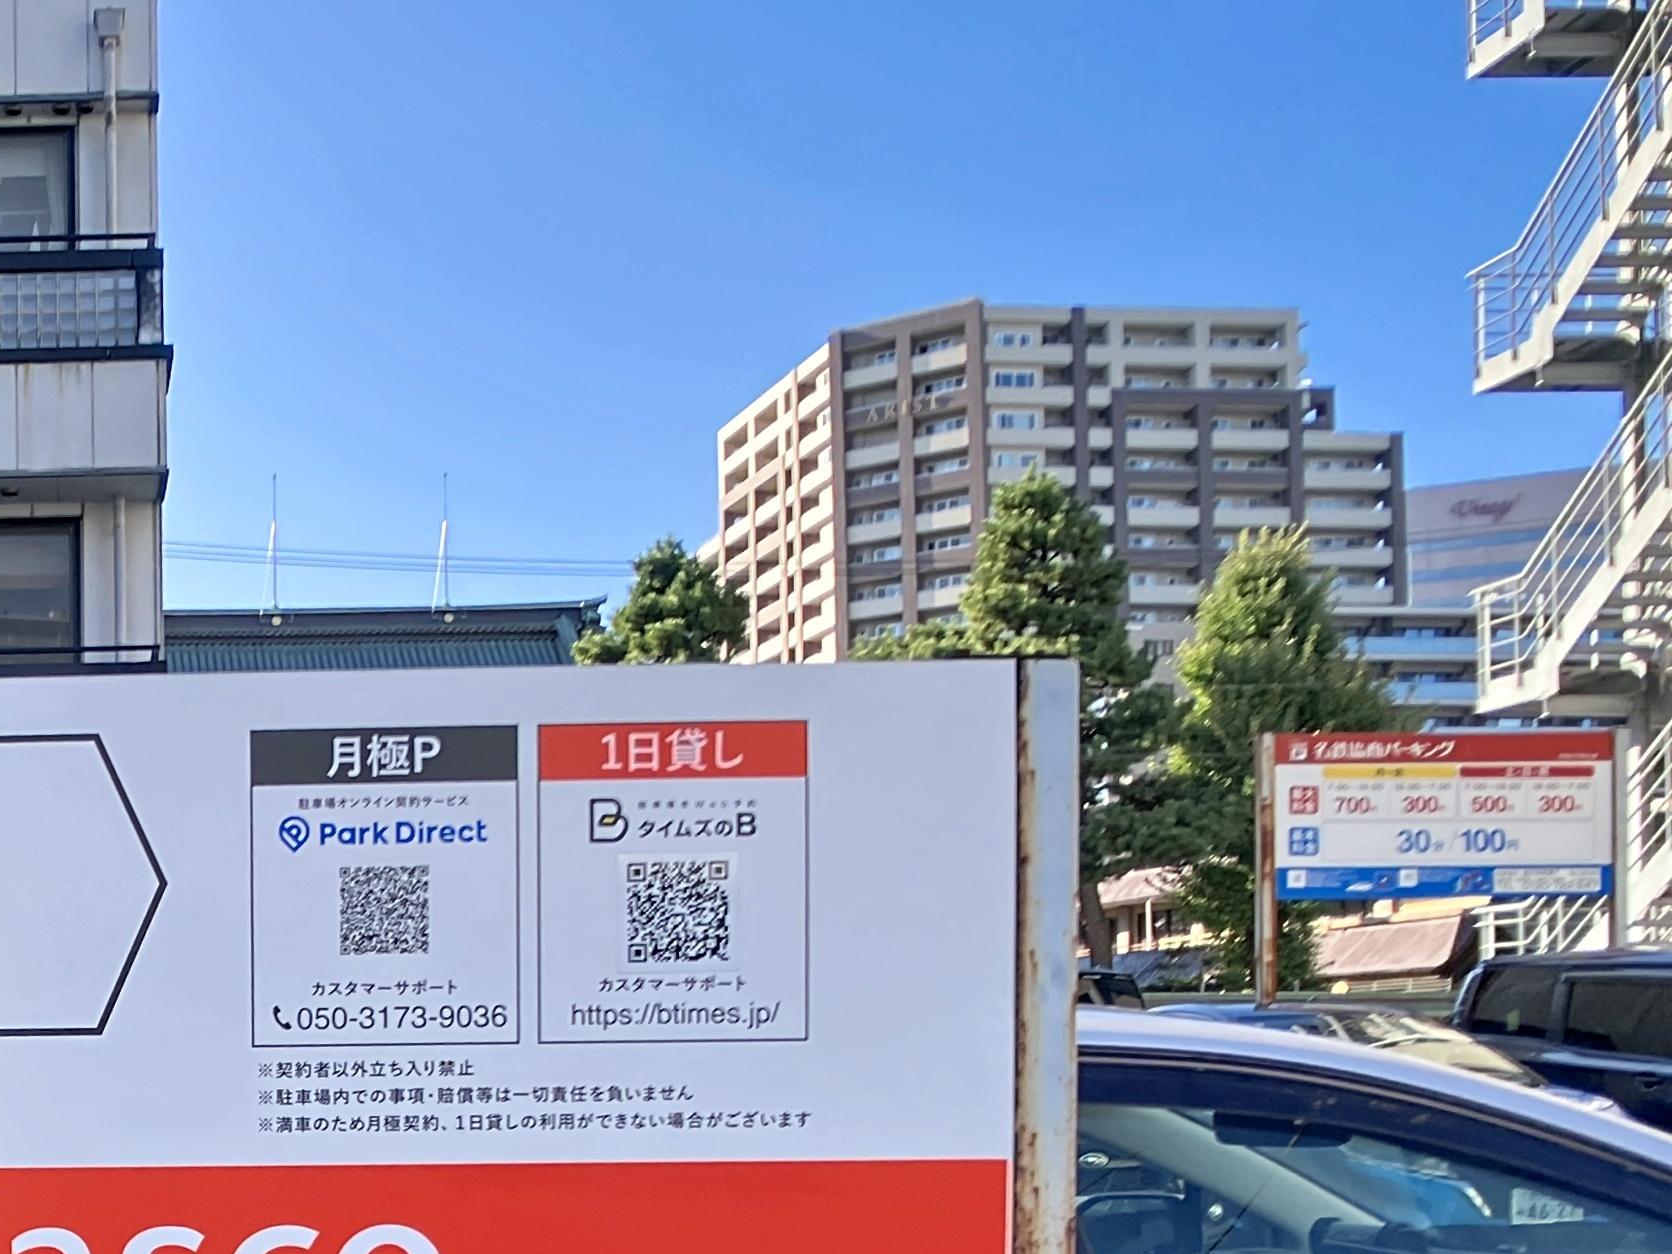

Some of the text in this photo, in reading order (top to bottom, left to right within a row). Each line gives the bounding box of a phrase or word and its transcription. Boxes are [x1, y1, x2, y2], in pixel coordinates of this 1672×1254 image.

[326, 734, 442, 778] 月極P
[600, 730, 744, 773] 1日貸し
[299, 796, 467, 809] 駐車場オンライン契約サービス
[320, 820, 487, 845] Park Direct
[639, 813, 756, 838] タイムズのB
[313, 980, 456, 996] カスタマーサポート
[600, 976, 744, 992] カスタマーサポート
[296, 1004, 508, 1031] 050-3173-9036
[572, 1002, 780, 1028] https://btimes.jp/
[259, 1060, 474, 1078] ※契約者以外立ち入り禁止
